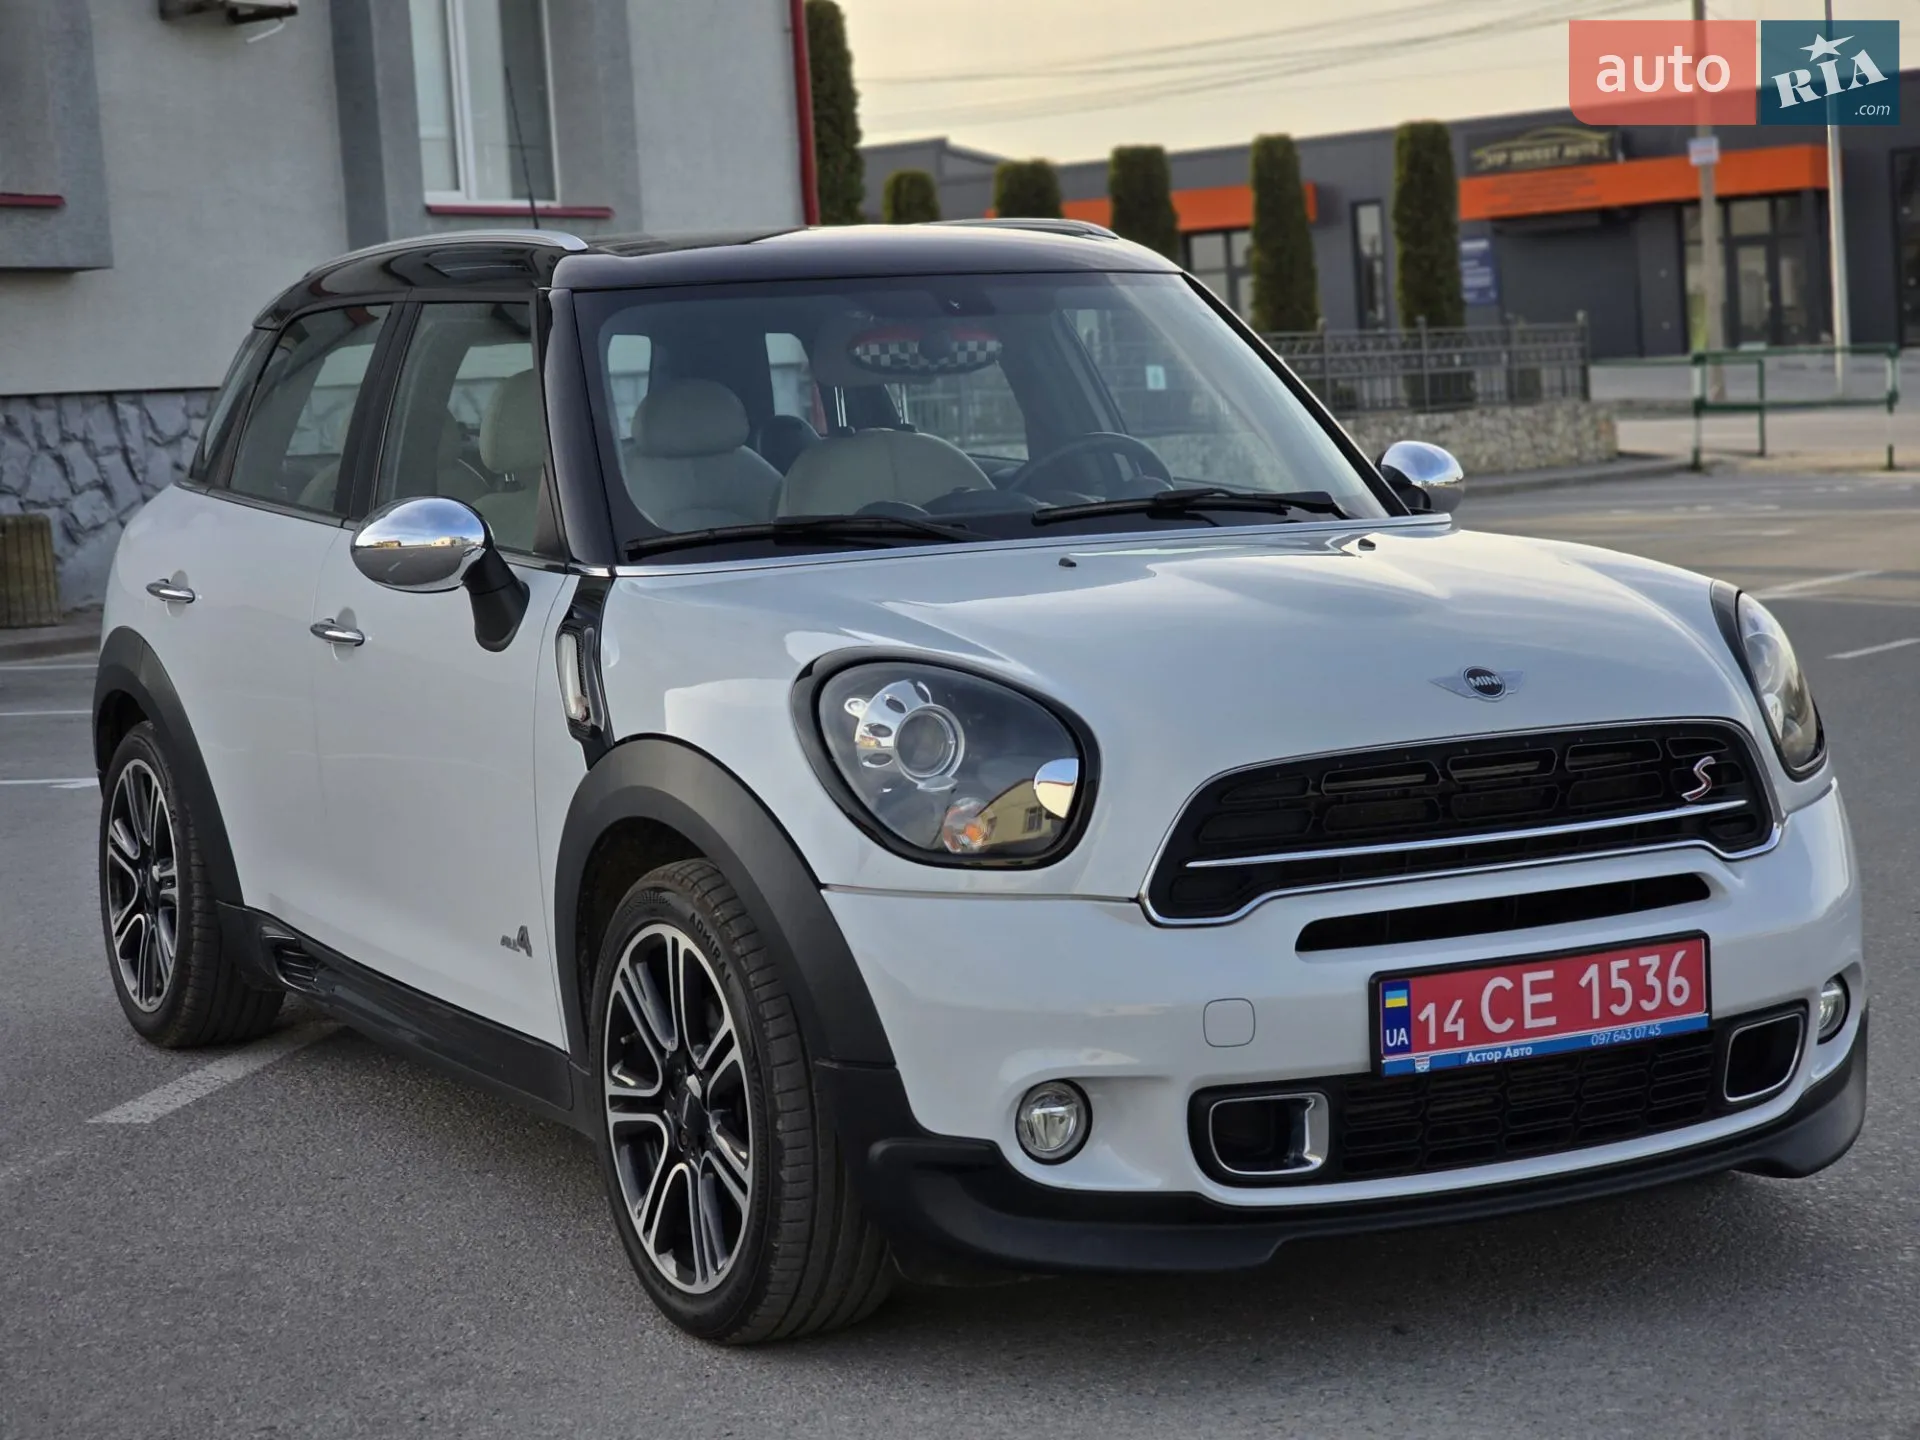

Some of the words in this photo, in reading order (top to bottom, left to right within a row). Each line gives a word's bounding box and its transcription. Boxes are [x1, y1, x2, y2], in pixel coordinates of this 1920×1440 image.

[1468, 675, 1502, 687] MINI
[1681, 755, 1716, 801] S
[689, 911, 731, 983] ADMIRAL
[1417, 999, 1465, 1045] 14
[1480, 969, 1557, 1034] CE
[1578, 950, 1691, 1020] 1536
[1385, 1027, 1409, 1047] UA
[1591, 1031, 1611, 1046] 097
[1612, 1027, 1633, 1042] 643
[1634, 1025, 1647, 1039] 07
[1648, 1023, 1662, 1036] 45
[1465, 1050, 1501, 1063] Астор
[1503, 1046, 1533, 1059] Авто
